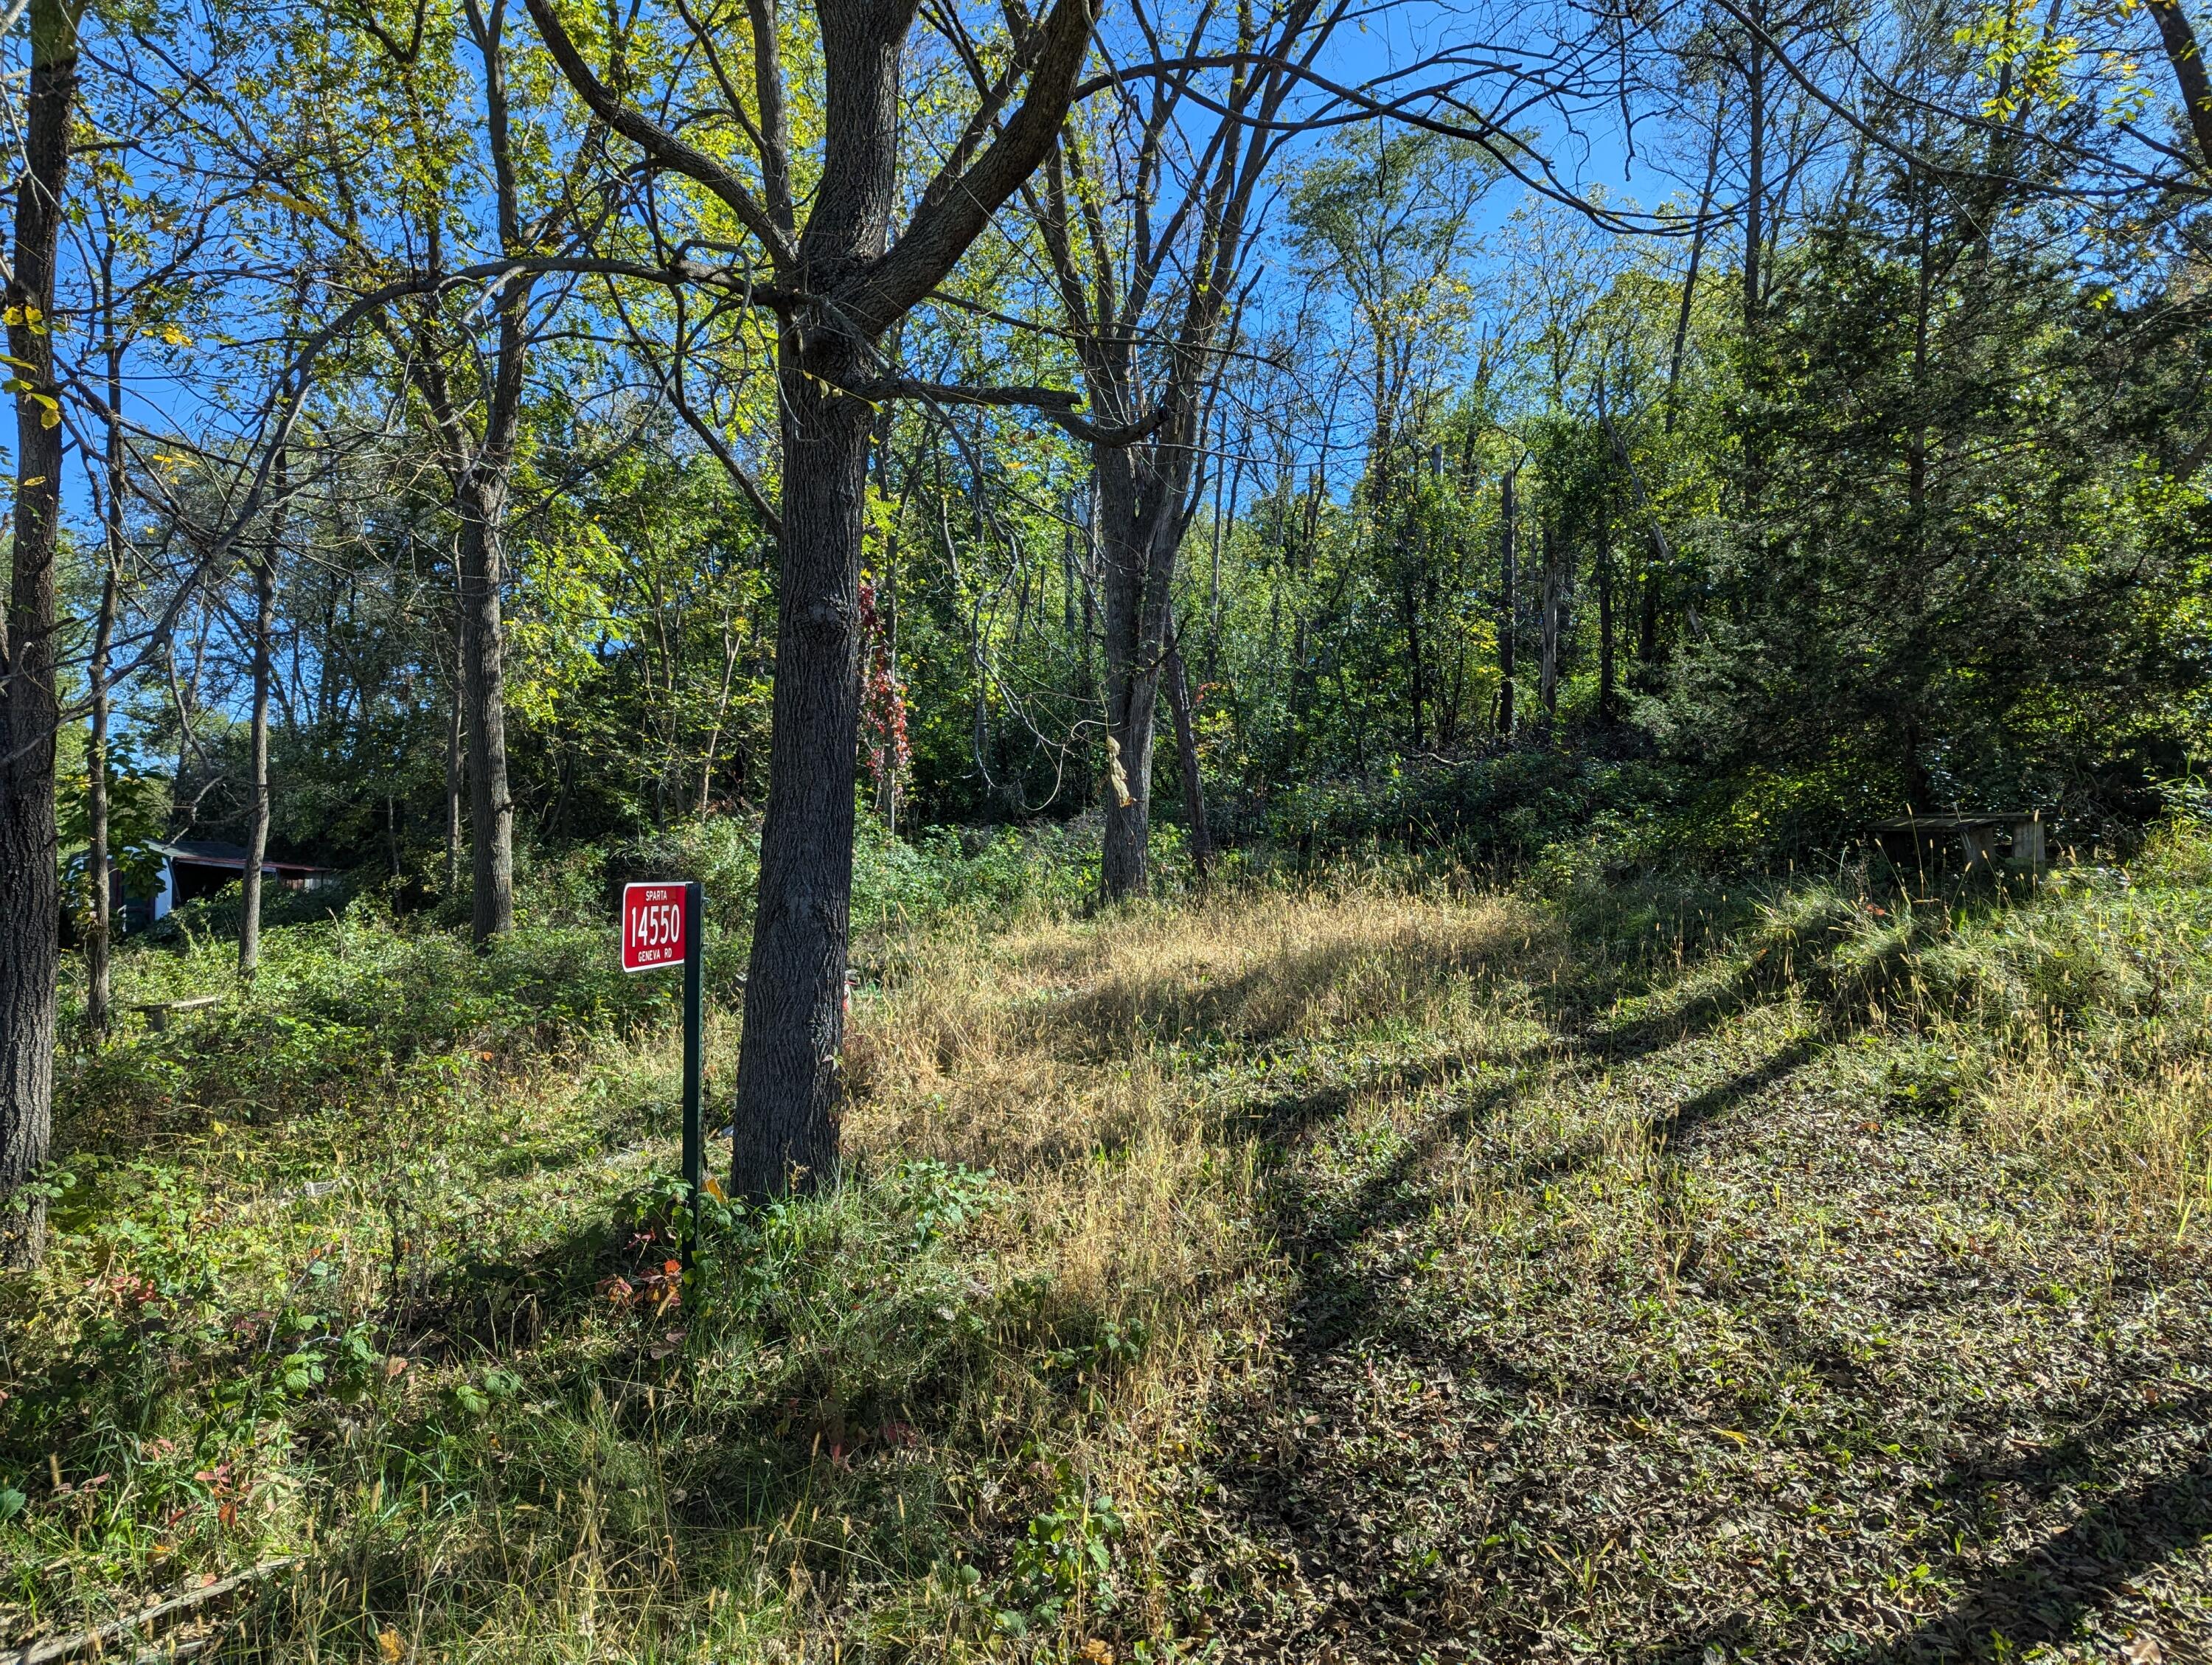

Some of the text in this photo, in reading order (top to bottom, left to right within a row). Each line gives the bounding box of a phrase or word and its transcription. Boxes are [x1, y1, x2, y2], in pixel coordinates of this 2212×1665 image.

[646, 890, 667, 901] SPARTA
[632, 904, 680, 948] 14550
[638, 948, 672, 962] GENEVA RD
